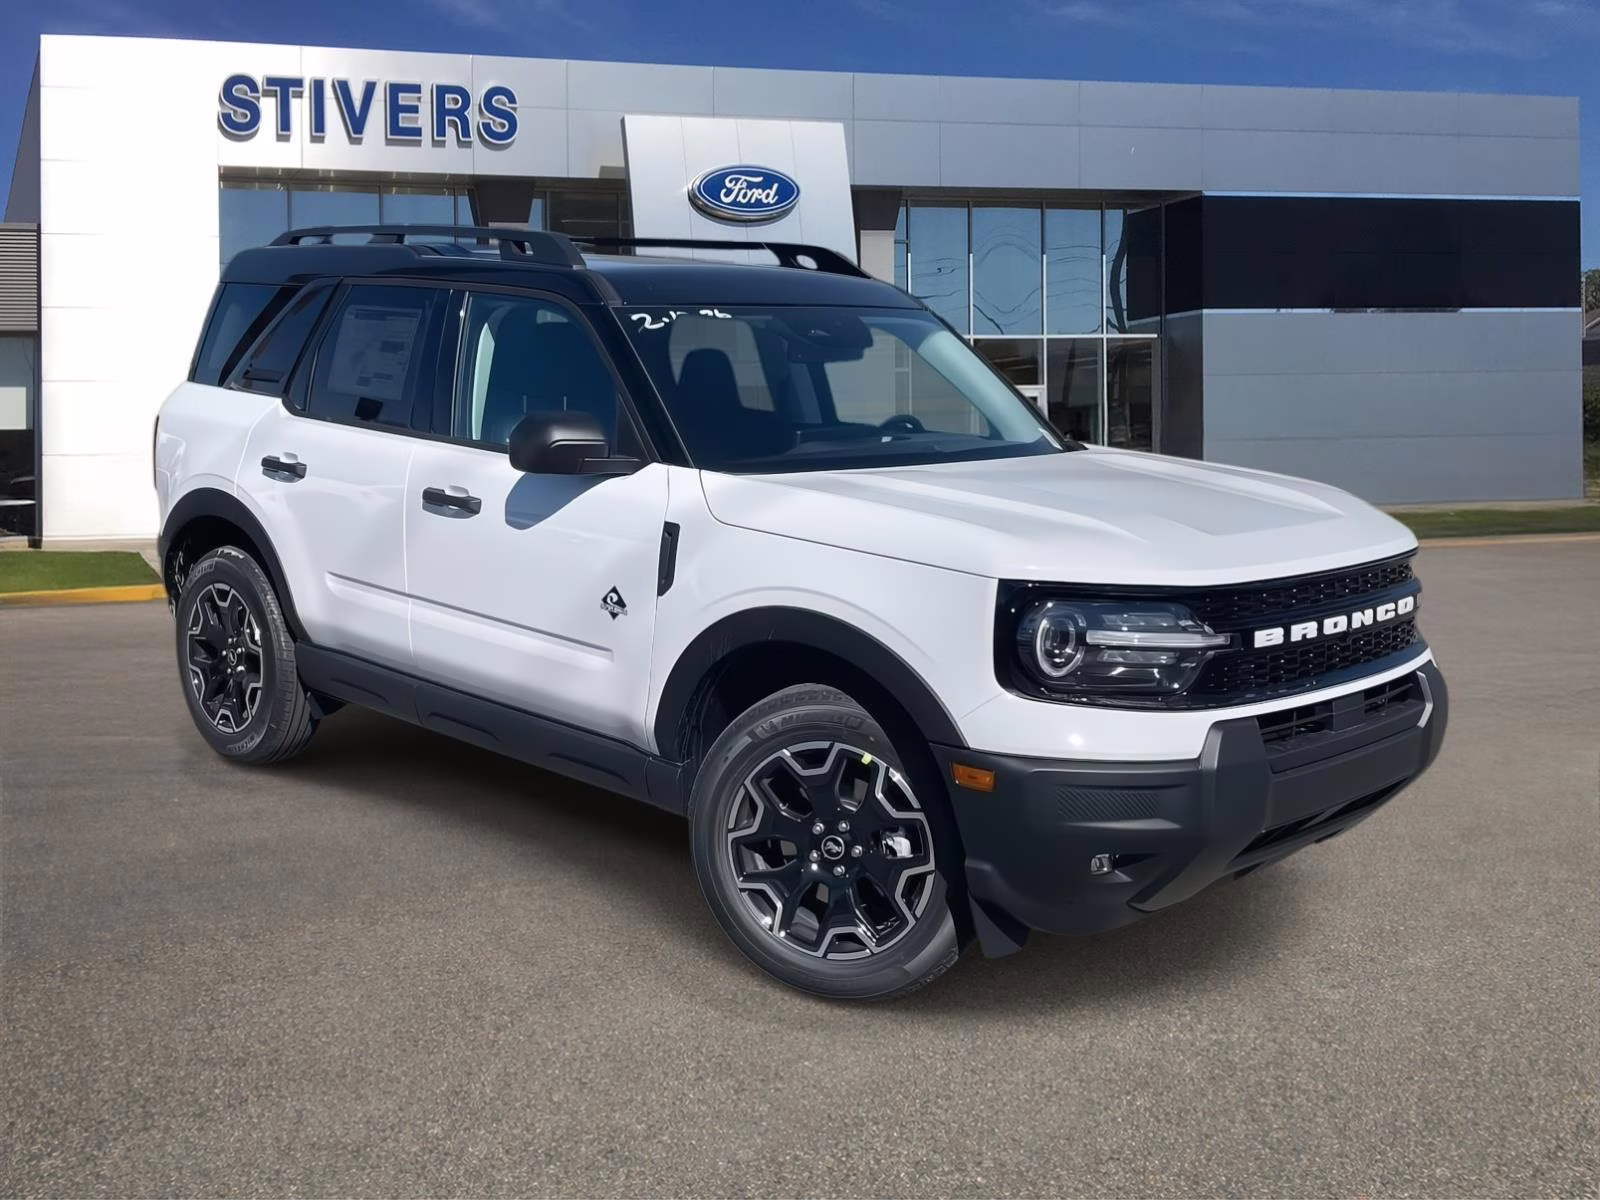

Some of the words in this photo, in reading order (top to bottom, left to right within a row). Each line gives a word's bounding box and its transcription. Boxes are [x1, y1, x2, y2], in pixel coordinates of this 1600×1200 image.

[218, 73, 518, 147] STIVERS
[720, 174, 779, 204] Ford
[1253, 596, 1415, 648] BRONCO
